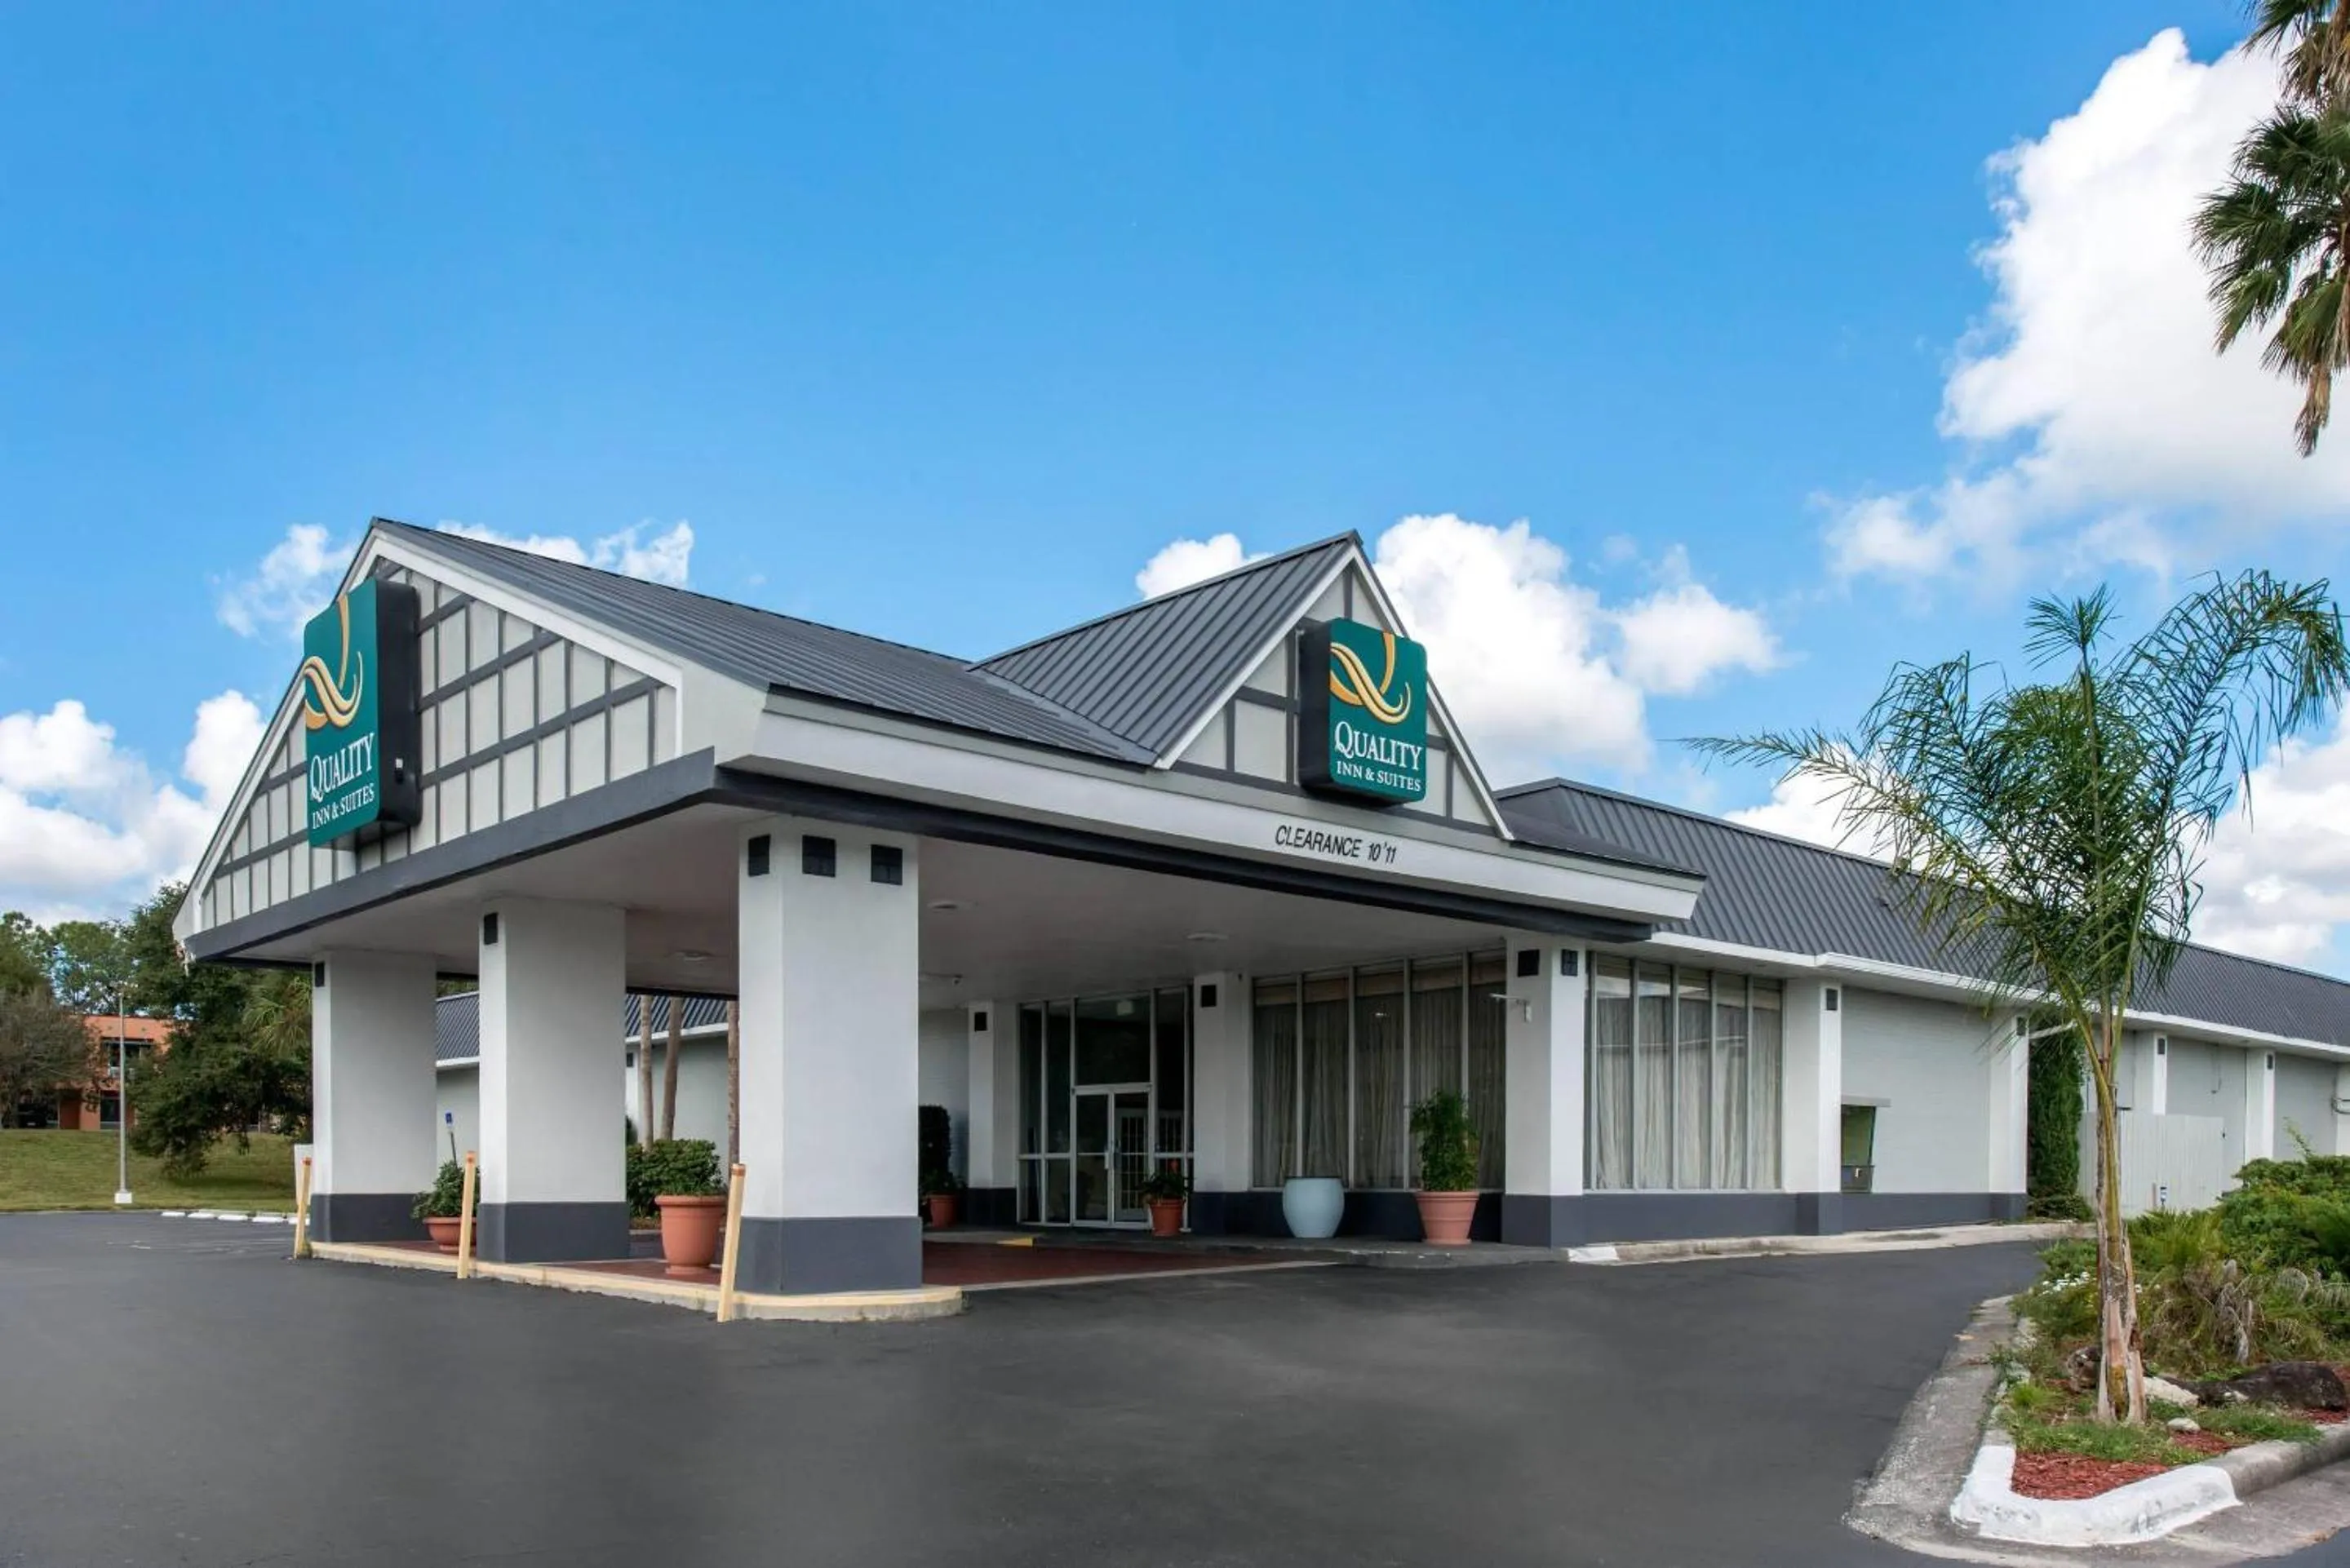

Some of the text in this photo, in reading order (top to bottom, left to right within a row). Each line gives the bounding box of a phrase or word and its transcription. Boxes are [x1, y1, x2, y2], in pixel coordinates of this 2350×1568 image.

[310, 732, 375, 803] QUALITY
[1334, 721, 1423, 770] QUALITY
[1337, 760, 1421, 791] INN & SUITES
[313, 784, 375, 829] INN & SUITES
[1275, 825, 1363, 857] CLEARANCE
